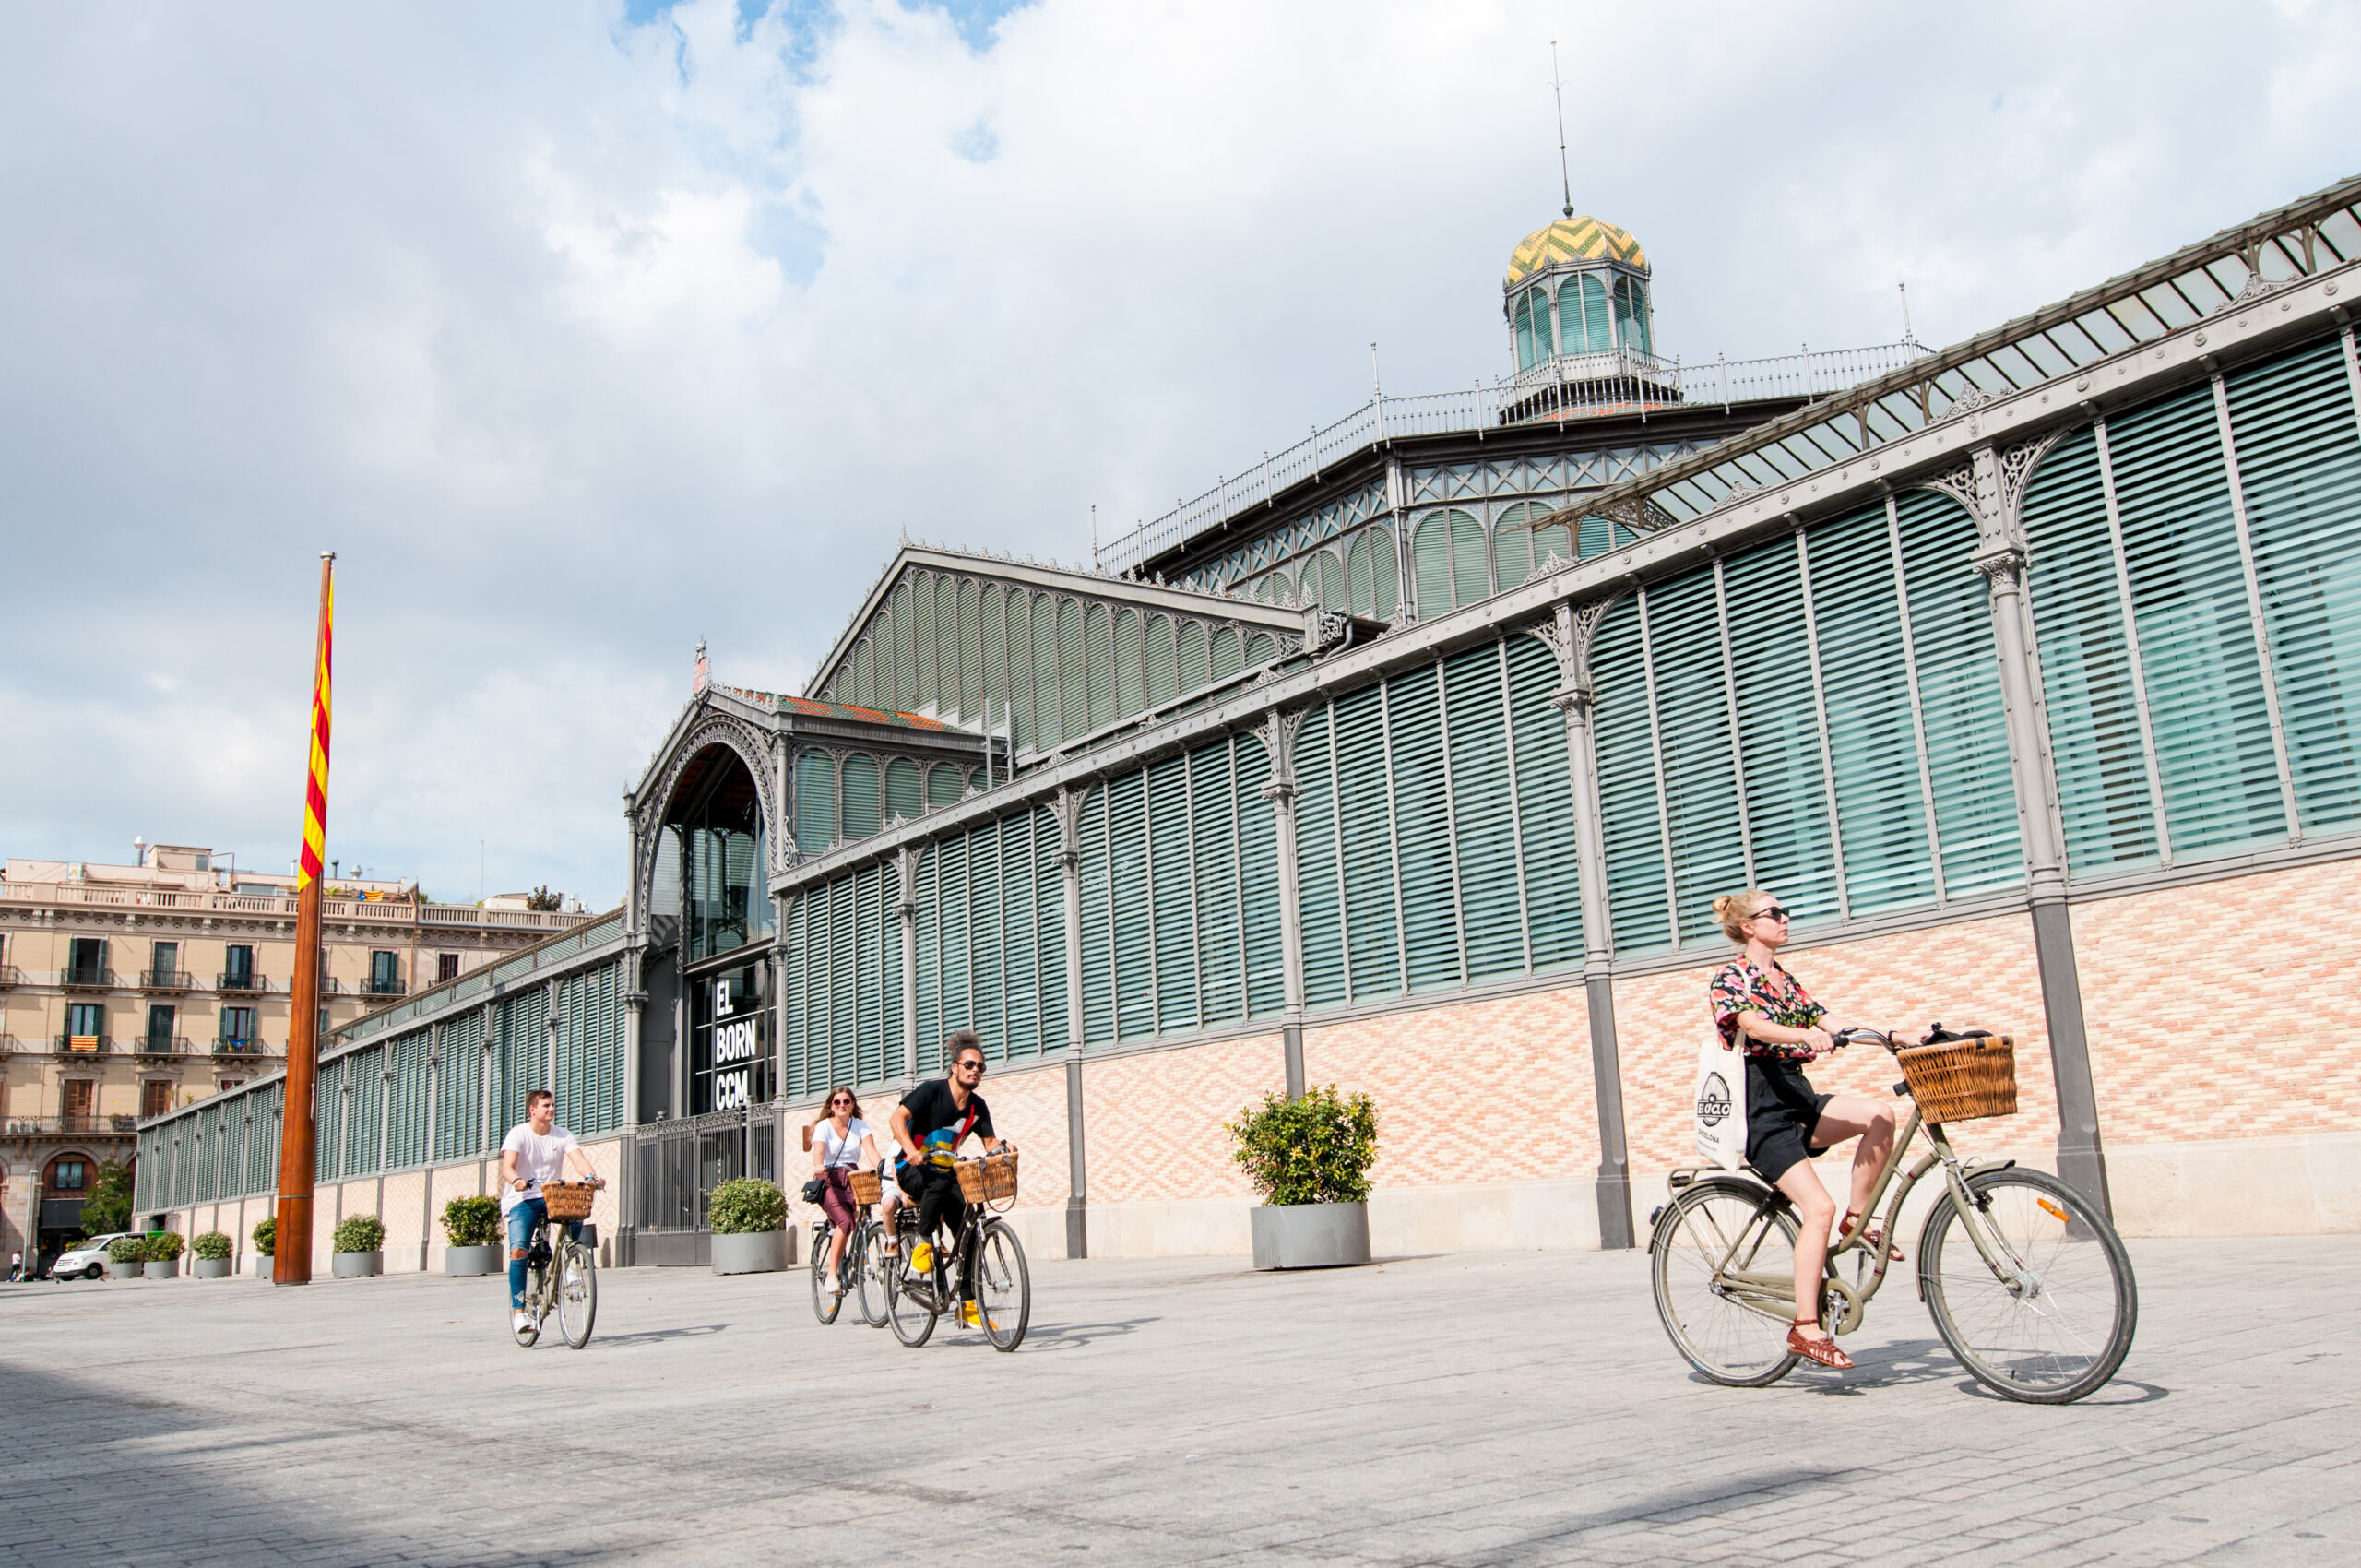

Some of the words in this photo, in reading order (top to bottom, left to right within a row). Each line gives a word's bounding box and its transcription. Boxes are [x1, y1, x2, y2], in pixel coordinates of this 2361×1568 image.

[717, 980, 733, 1016] EL
[716, 1019, 756, 1063] BORN
[716, 1070, 748, 1111] CCM
